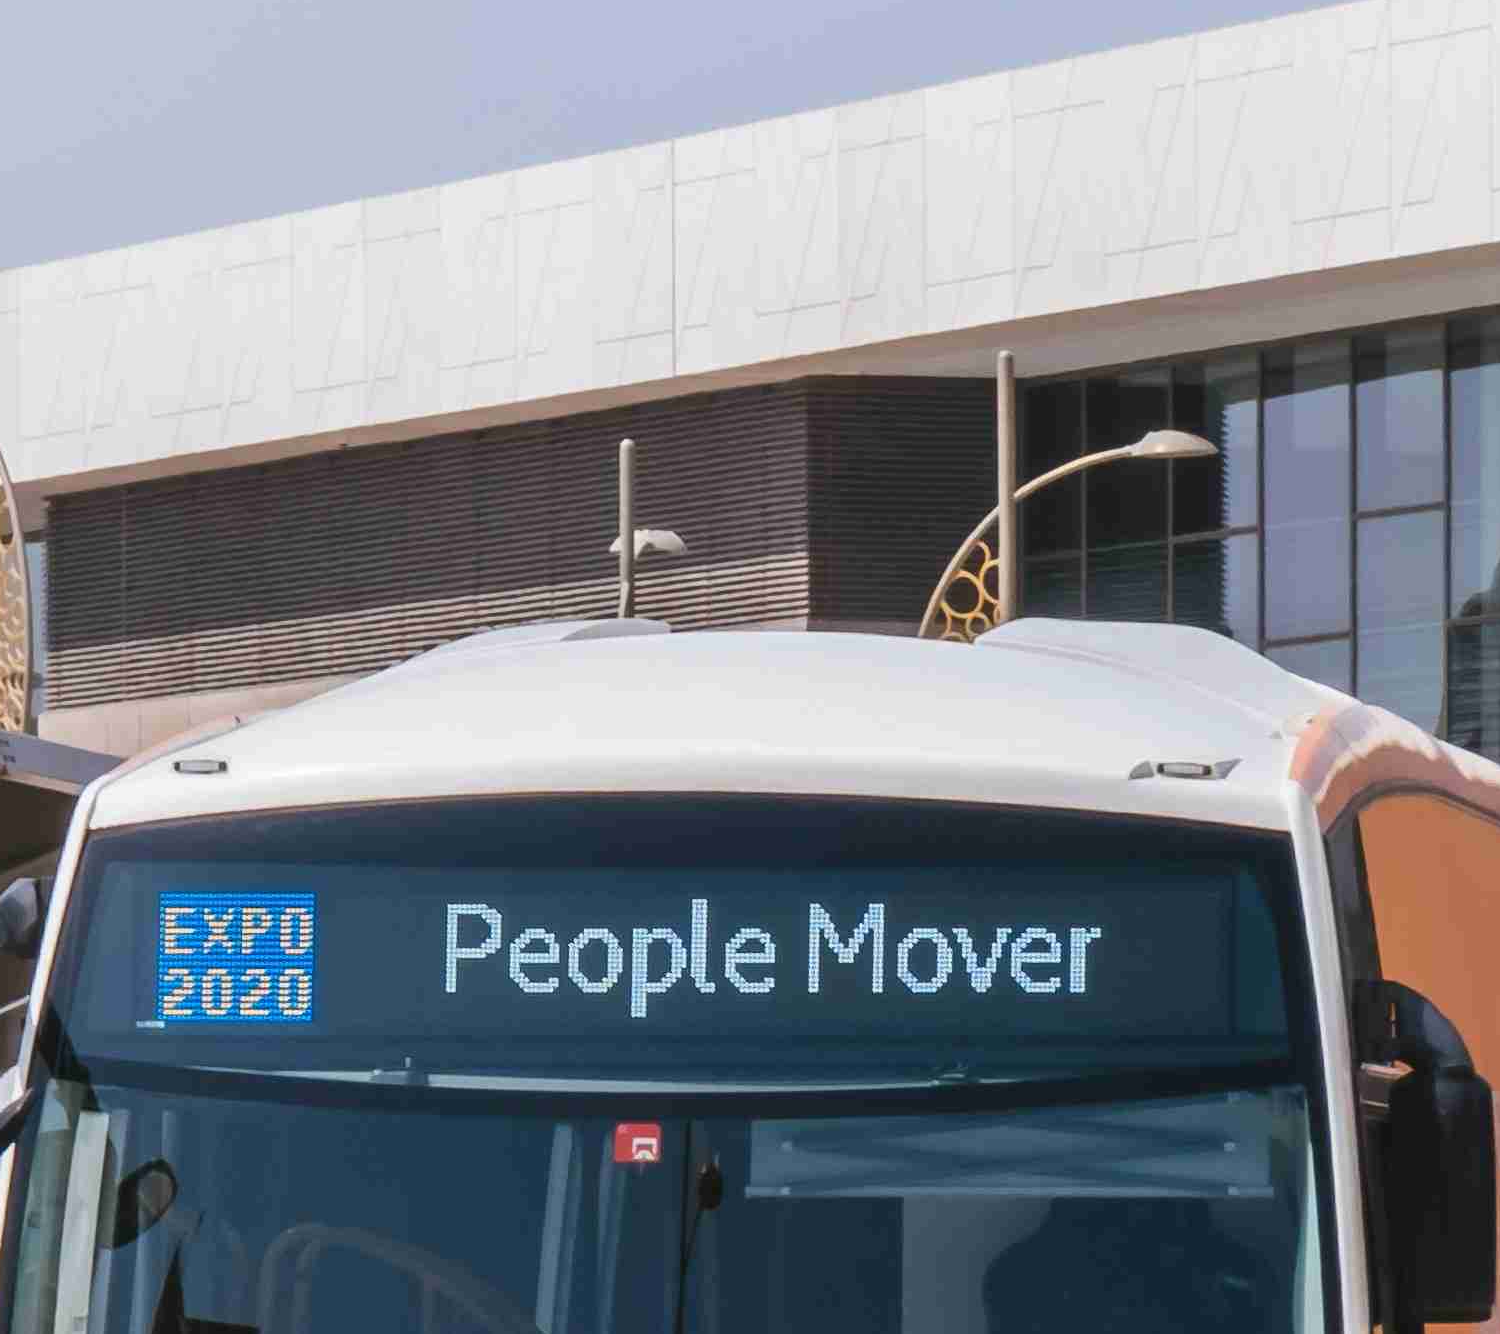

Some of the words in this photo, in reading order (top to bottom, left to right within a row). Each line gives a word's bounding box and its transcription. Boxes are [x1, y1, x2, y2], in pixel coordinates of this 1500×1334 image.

[164, 907, 313, 954] EXPO
[445, 898, 776, 1018] People
[808, 903, 1102, 993] Mover
[163, 968, 312, 1015] 2020
